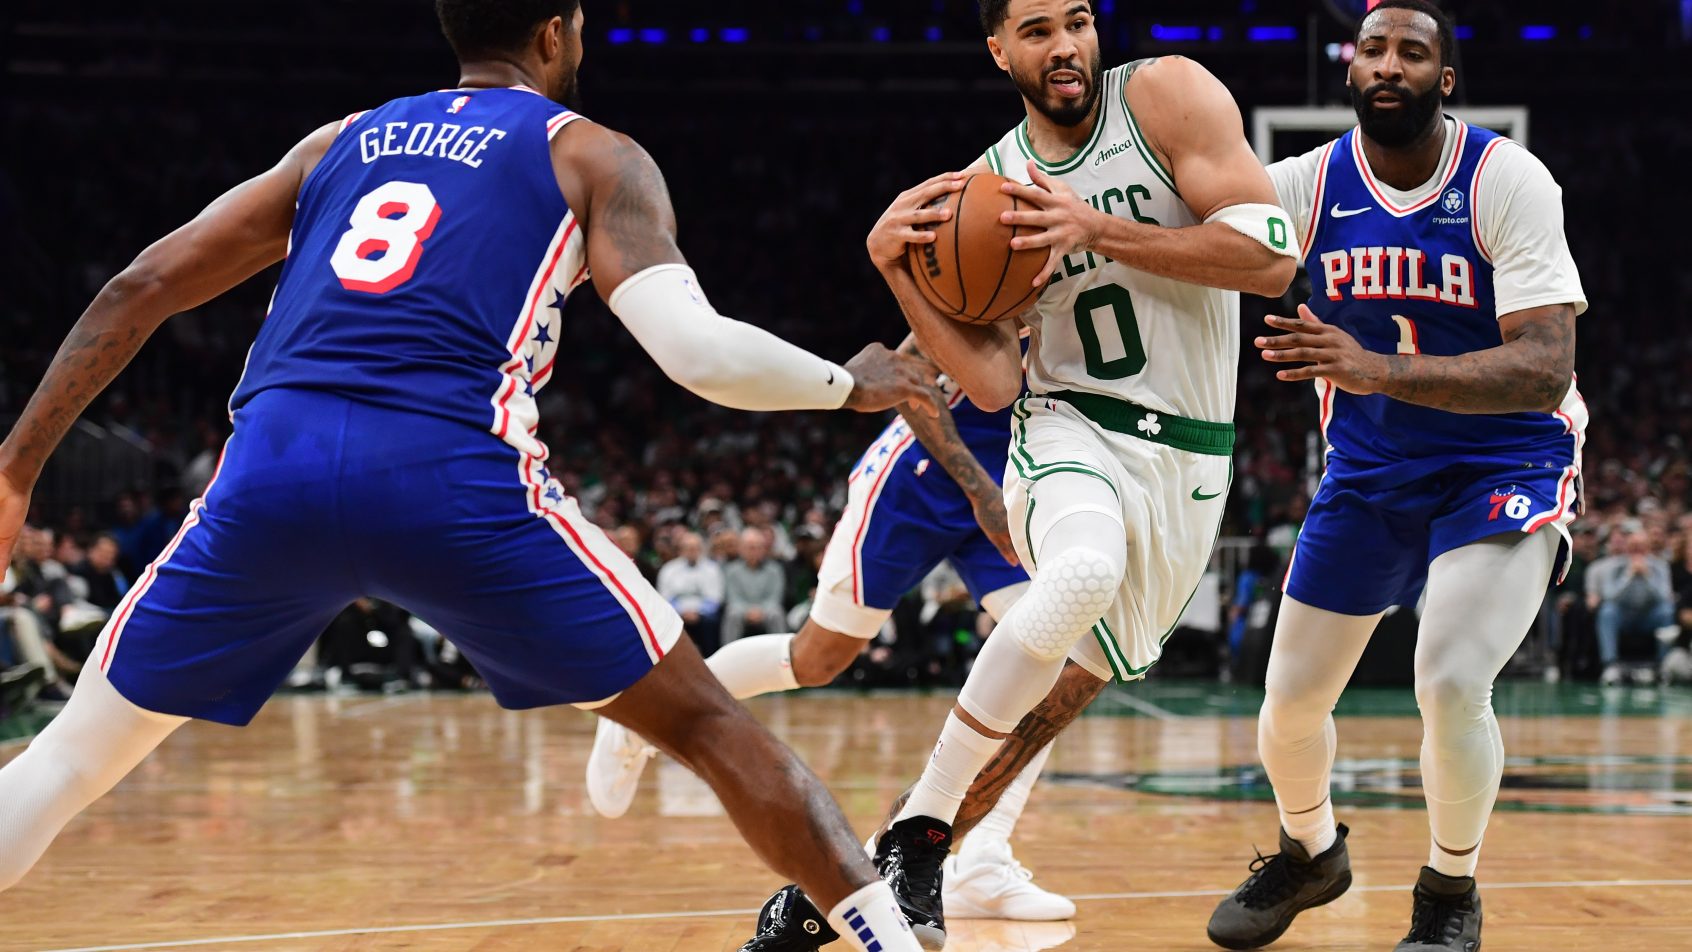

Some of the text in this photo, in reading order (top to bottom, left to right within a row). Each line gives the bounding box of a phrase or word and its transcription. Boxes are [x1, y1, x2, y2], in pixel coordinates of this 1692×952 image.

[360, 121, 507, 169] GEORGE
[1094, 138, 1133, 167] Amica
[330, 180, 443, 295] 8
[1266, 216, 1287, 250] 0
[1320, 246, 1479, 309] PHILA
[1073, 283, 1148, 380] 0
[1391, 314, 1422, 355] 1
[1488, 493, 1532, 522] 76
